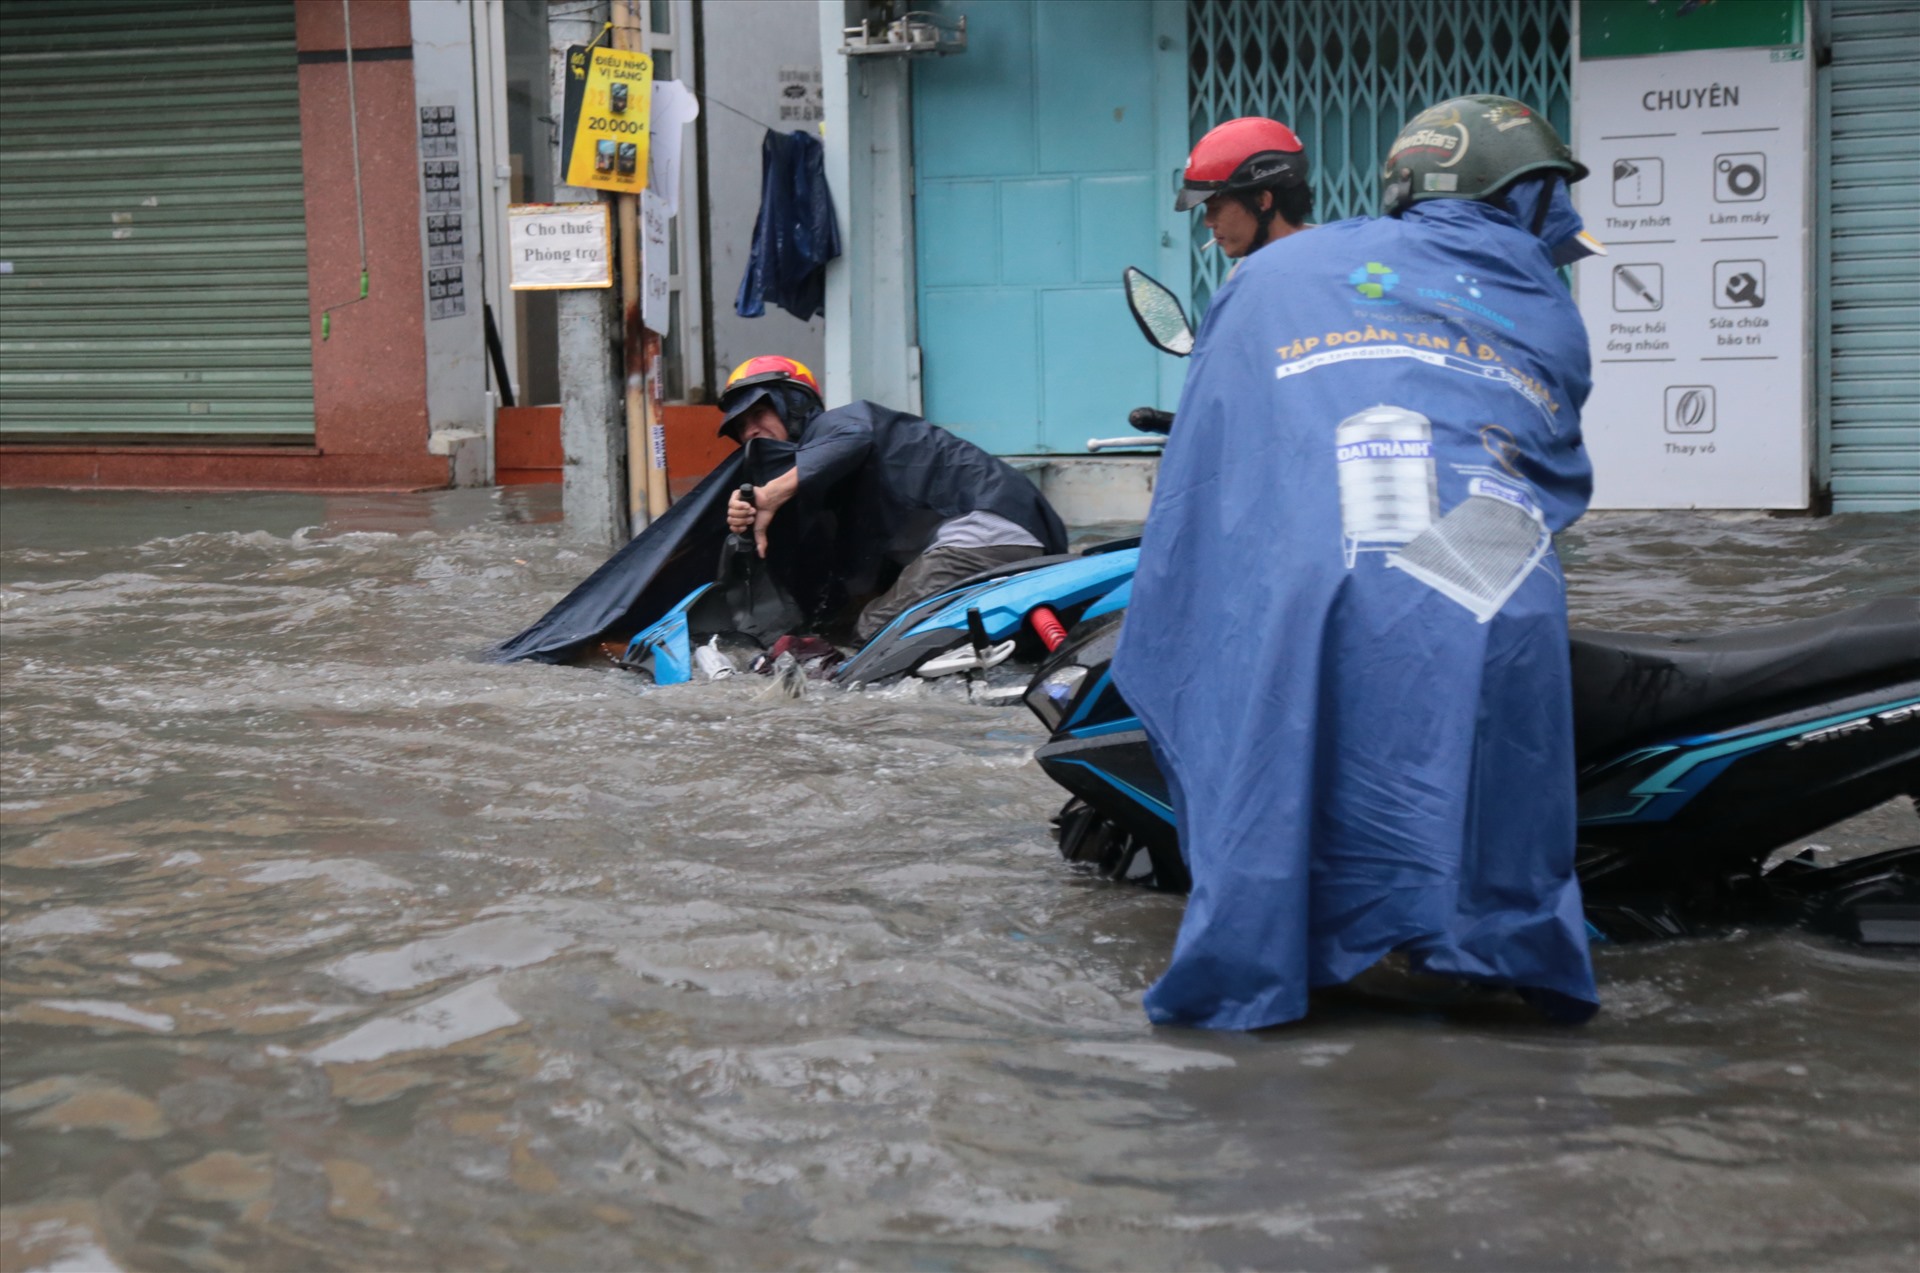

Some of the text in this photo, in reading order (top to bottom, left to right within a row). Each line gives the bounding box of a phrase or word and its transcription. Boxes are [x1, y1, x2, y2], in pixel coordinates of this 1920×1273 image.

[613, 69, 643, 81] SANG
[1642, 83, 1740, 111] CHUYÊN
[1606, 216, 1671, 230] Thay nhớt
[1709, 211, 1770, 225] Làm máy
[525, 221, 593, 236] Cho thuê
[575, 248, 598, 262] trọ
[1610, 323, 1642, 337] Phục
[1709, 317, 1769, 329] Sửa chữa
[1276, 337, 1320, 360] TẬP
[1325, 323, 1398, 346] ĐOÀN
[1403, 332, 1450, 350] TÂN
[1455, 336, 1472, 357] Á
[1635, 340, 1670, 351] nhún
[1717, 334, 1743, 346] bảo
[1665, 441, 1716, 456] Thay vỏ
